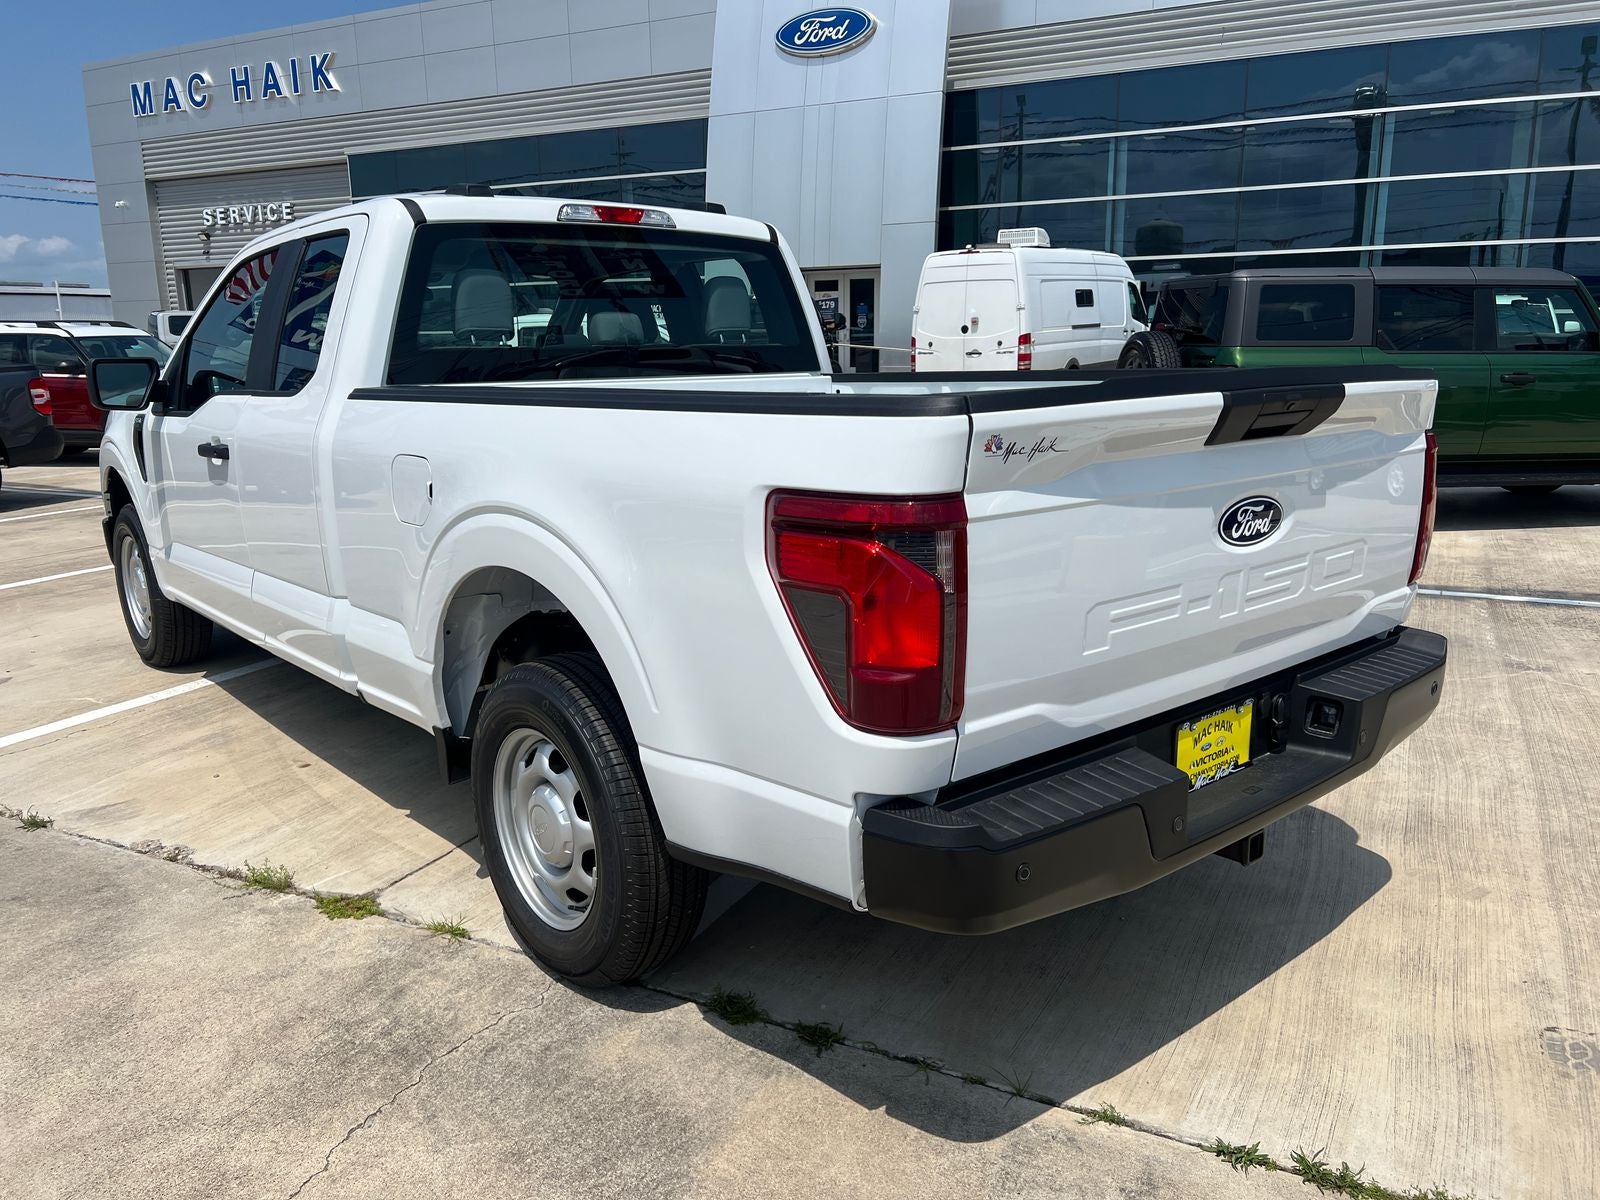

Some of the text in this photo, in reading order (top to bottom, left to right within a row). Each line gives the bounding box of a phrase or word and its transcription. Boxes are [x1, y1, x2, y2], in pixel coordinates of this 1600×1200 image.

[793, 15, 851, 45] Ford
[129, 51, 336, 118] MAC HAIK
[202, 202, 294, 227] SERVICE
[998, 436, 1069, 465] Mac Haik
[1231, 504, 1275, 539] Ford
[1082, 538, 1369, 656] F-150
[1193, 723, 1213, 750] MAC
[1214, 719, 1234, 734] HAIK
